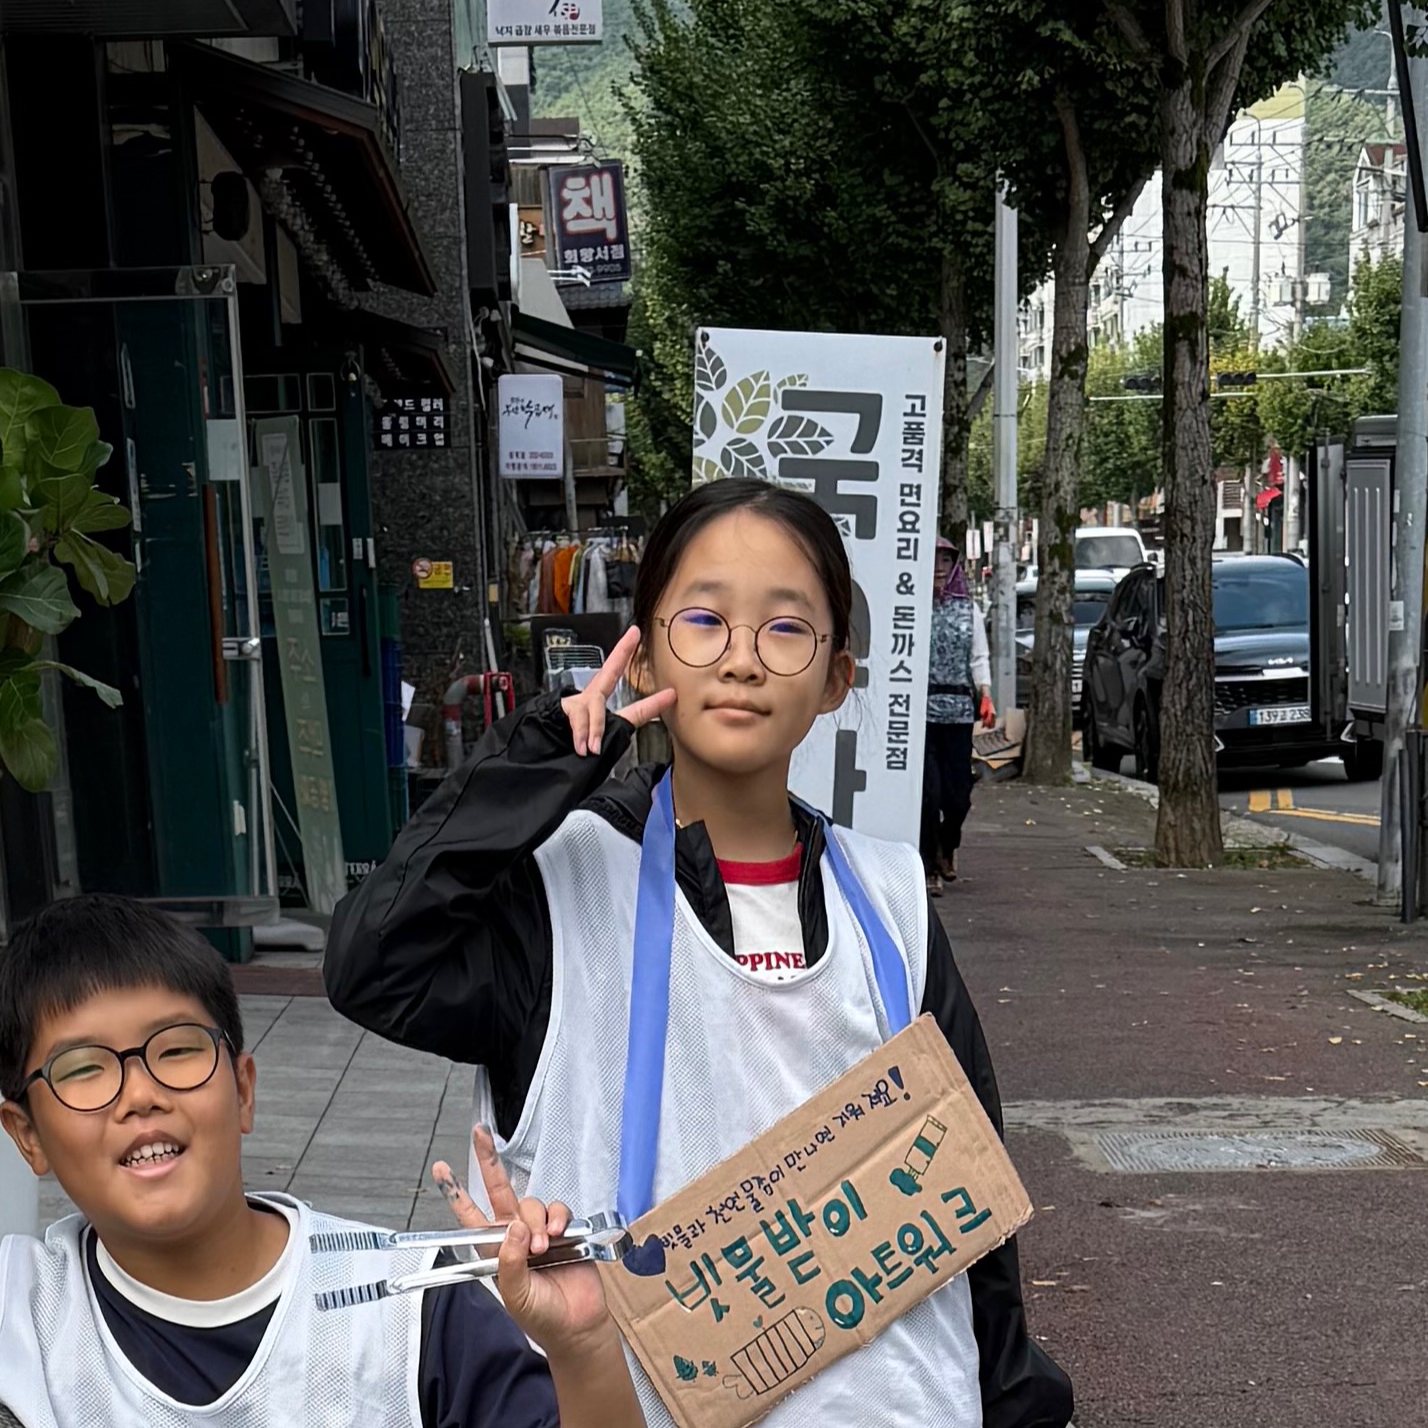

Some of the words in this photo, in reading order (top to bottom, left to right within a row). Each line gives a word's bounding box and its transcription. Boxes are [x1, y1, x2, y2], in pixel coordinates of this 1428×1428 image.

[561, 172, 617, 240] 책
[900, 393, 928, 474] 고품격
[895, 482, 923, 562] 면요리
[894, 572, 917, 597] &
[888, 605, 918, 684] 돈까스
[885, 693, 912, 772] 전문점
[825, 1186, 993, 1330] 아트워크
